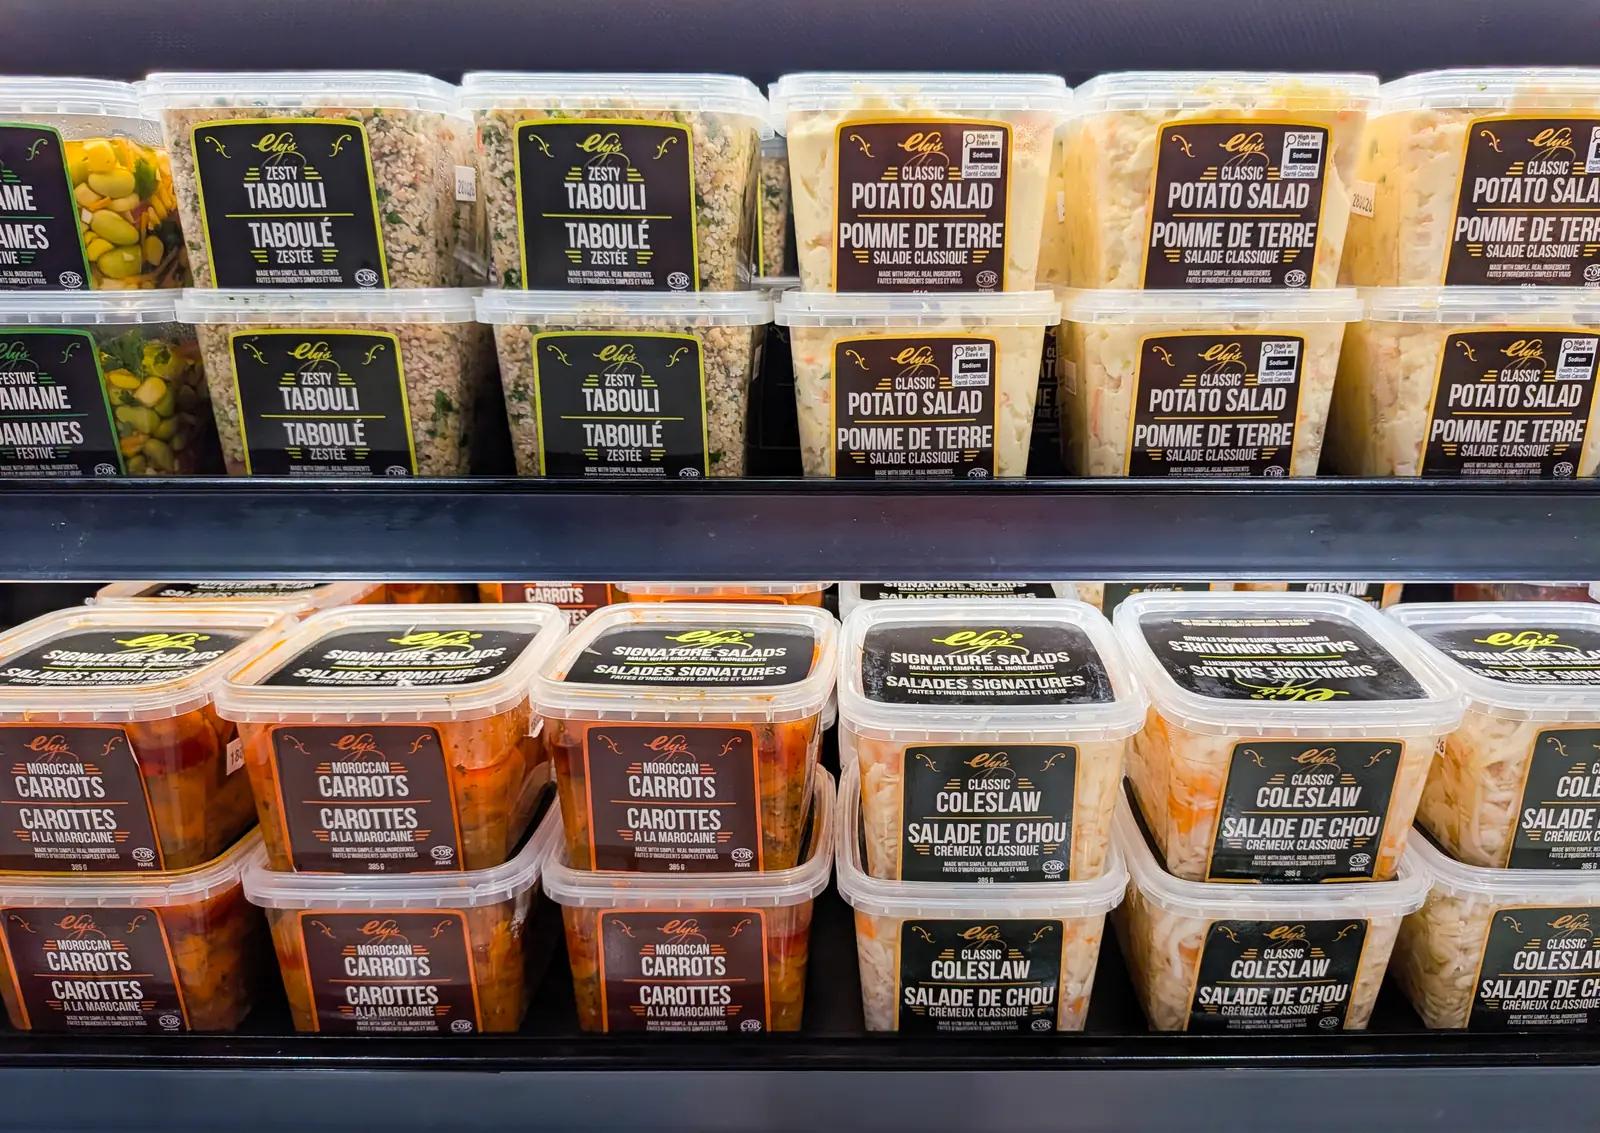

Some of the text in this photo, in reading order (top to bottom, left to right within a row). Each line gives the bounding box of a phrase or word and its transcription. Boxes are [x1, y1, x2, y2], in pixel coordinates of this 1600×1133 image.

[266, 166, 297, 181] ZESTY
[588, 167, 620, 182] ZESTY
[902, 166, 944, 181] CLASSIC
[1221, 166, 1264, 181] CLASSIC
[244, 182, 327, 209] TABOULI
[564, 183, 646, 210] TABOULI
[852, 182, 994, 209] POTATO SALAD
[1168, 183, 1310, 209] POTATO SALAD
[248, 217, 335, 248] TABOULÉ
[565, 219, 650, 249] TABOULÉ
[840, 222, 1004, 249] POMME DE TERRE
[1152, 222, 1317, 248] POMME DE TERRE
[276, 248, 315, 264] ZESTÉE
[590, 249, 628, 265] ZESTÉE
[873, 251, 968, 265] SALADE CLASSIQUE
[1185, 250, 1280, 264] SALADE CLASSIQUE
[300, 372, 332, 385] ZESTY
[895, 377, 936, 390] CLASSIC
[1500, 370, 1541, 382] CLASSIC
[278, 387, 360, 411] TABOULI
[848, 390, 982, 416] POTATO SALAD
[1448, 384, 1583, 408] POTATO SALAD
[282, 419, 367, 446] TABOULÉ
[838, 425, 993, 451] POMME DE TERRE
[1430, 419, 1587, 442] POMME DE TERRE
[16, 447, 56, 459] FESTIVE
[310, 446, 347, 460] ZESTÉE
[869, 451, 960, 465] SALADE CLASSIQUE
[1461, 444, 1550, 457] SALADE CLASSIQUE
[525, 588, 584, 603] CARROTS
[323, 647, 506, 661] SIGNATURE SALADS
[612, 646, 787, 657] SIGNATURE SALADS
[1168, 640, 1360, 654] SALADES SIGNATURES
[891, 652, 1071, 665] SIGNATURE SALADS
[293, 665, 495, 680] SALADES SIGNATURES
[594, 664, 787, 677] SALADES SIGNATURES
[1193, 665, 1378, 678] SIGNATURE SALADS
[886, 675, 1086, 690] SALADES SIGNATURES
[27, 763, 84, 775] MOROCCAN
[332, 762, 390, 774] MOROCCAN
[643, 763, 699, 775] MOROCCAN
[15, 776, 105, 798] CARROTS
[319, 775, 410, 798] CARROTS
[628, 776, 716, 798] CARROTS
[968, 779, 1011, 790] CLASSIC
[1291, 774, 1334, 786] CLASSIC
[937, 791, 1042, 813] COLESLAW
[1256, 787, 1362, 807] COLESLAW
[19, 808, 117, 830] CAROTTES
[320, 808, 418, 830] CAROTTES
[627, 808, 721, 831] CAROTTES
[908, 822, 1067, 844] SALADE DE CHOU
[1223, 816, 1380, 838] SALADE DE CHOU
[40, 832, 54, 843] LA
[55, 832, 115, 844] MAROCAINE
[341, 831, 353, 843] LA
[355, 831, 414, 843] MAROCAINE
[644, 832, 657, 843] LA
[658, 832, 716, 844] MAROCAINE
[1246, 838, 1350, 851] CRÉMEUX CLASSIQUE
[934, 844, 1039, 857] CRÉMEUX CLASSIQUE
[657, 944, 710, 955] MOROCCAN
[961, 949, 1002, 960] CLASSIC
[641, 956, 726, 977] CARROTS
[931, 960, 1031, 980] COLESLAW
[639, 985, 731, 1005] CAROTTES
[904, 986, 1056, 1007] SALADE DE CHOU
[656, 1006, 668, 1017] LA
[670, 1006, 725, 1017] MAROCAINE
[977, 1006, 1028, 1017] CLASSIQUE
